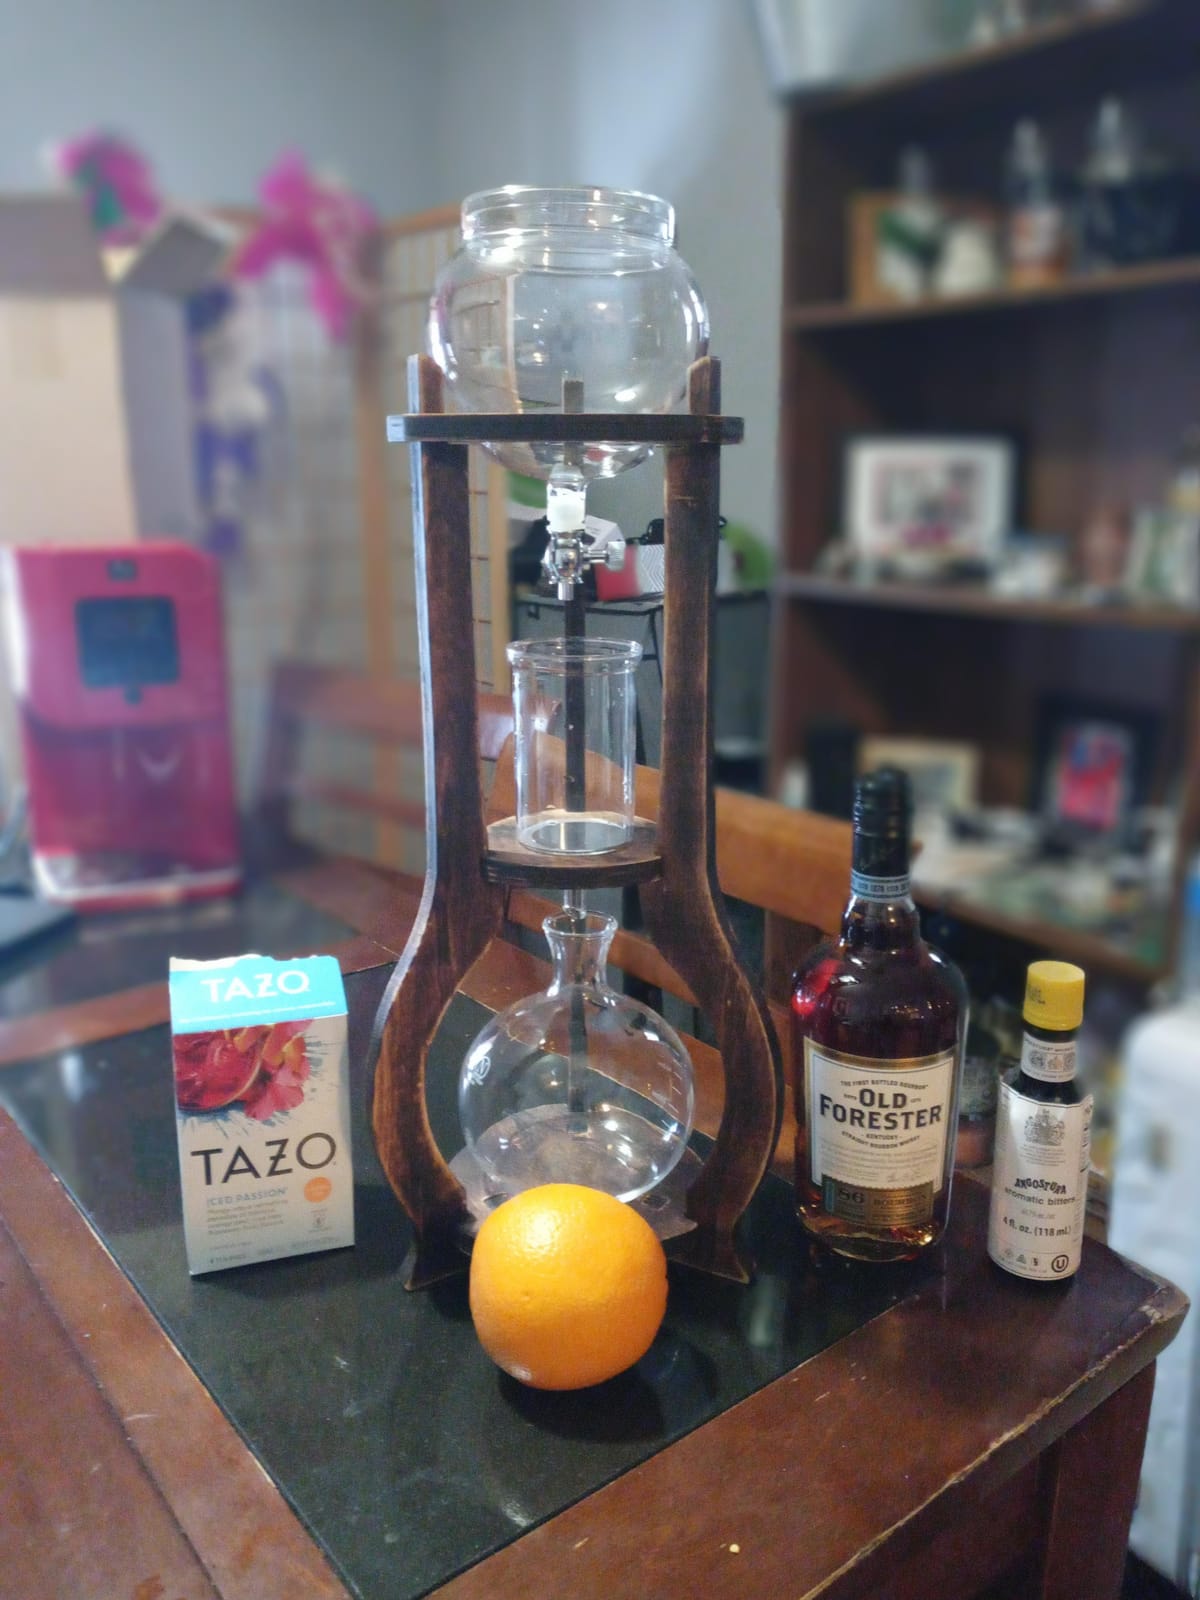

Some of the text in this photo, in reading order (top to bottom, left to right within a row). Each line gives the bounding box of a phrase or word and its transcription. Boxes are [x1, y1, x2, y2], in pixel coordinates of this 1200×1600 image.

[201, 969, 311, 1004] TAZO
[859, 1088, 908, 1109] OLD
[820, 1093, 943, 1131] FORESTER
[191, 1132, 337, 1187] TAZO
[1004, 1187, 1076, 1206] aromatic bitters
[1014, 1178, 1067, 1195] ANGOSTURA
[1002, 1216, 1008, 1225] 4
[1019, 1224, 1032, 1234] oz.
[1034, 1227, 1055, 1237] (118
